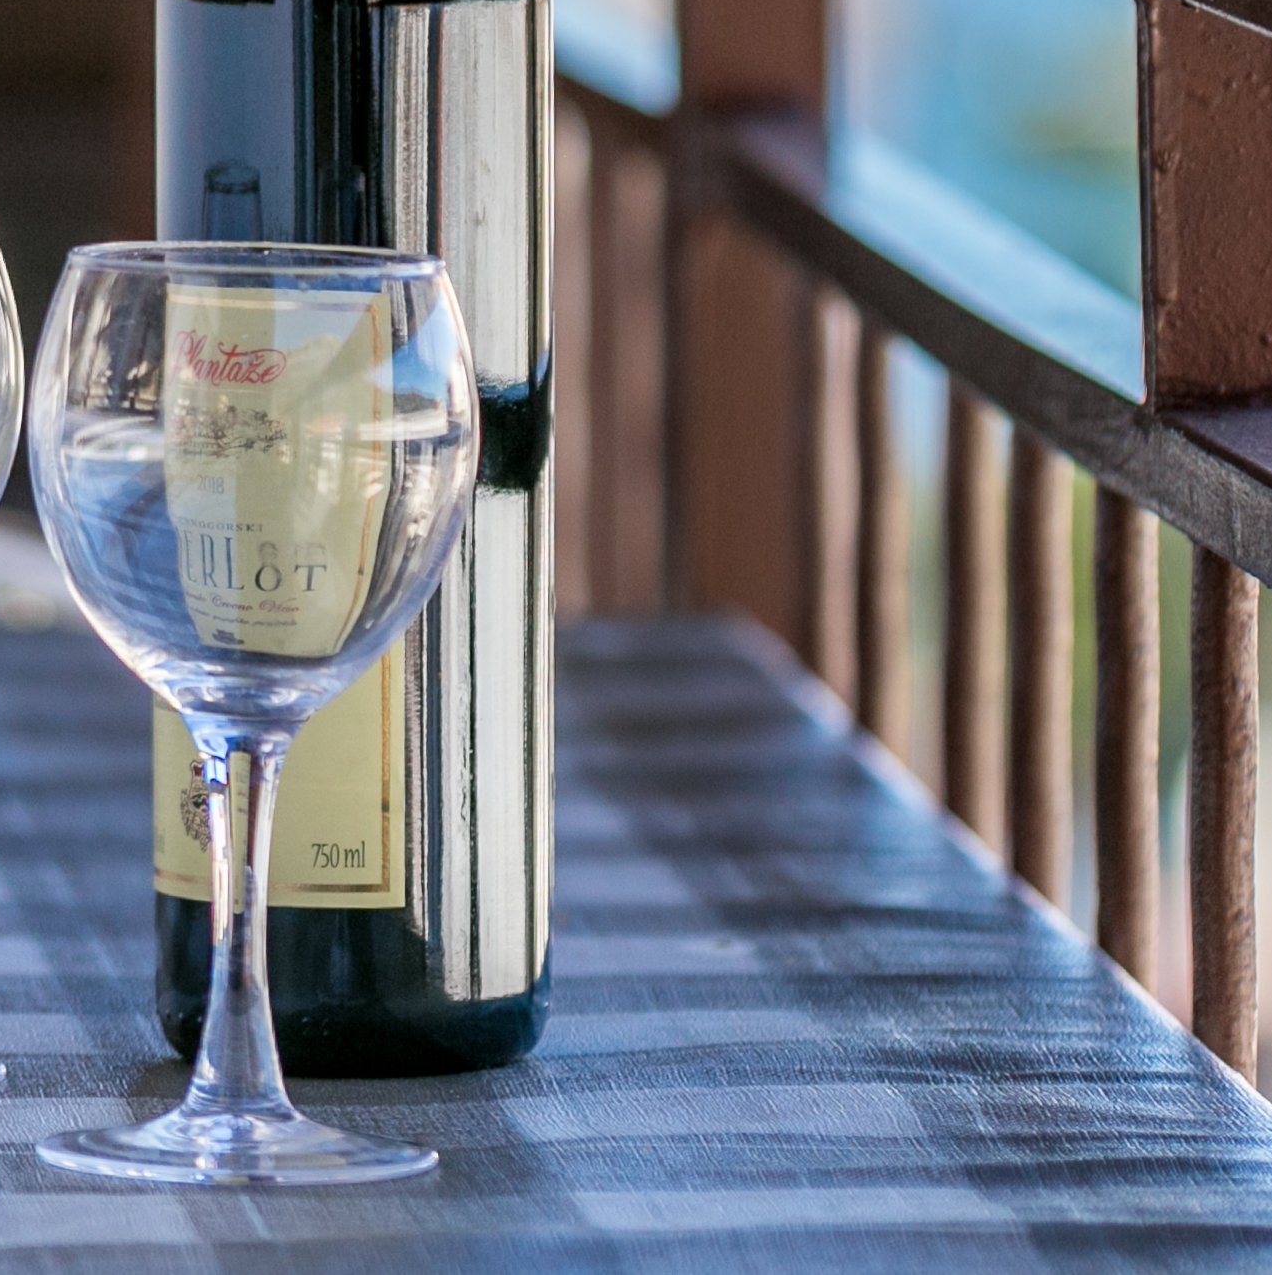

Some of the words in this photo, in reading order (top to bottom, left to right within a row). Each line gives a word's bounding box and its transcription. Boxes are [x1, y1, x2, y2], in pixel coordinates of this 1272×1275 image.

[198, 475, 224, 494] 2018
[311, 843, 340, 868] 750
[344, 840, 366, 868] ml
